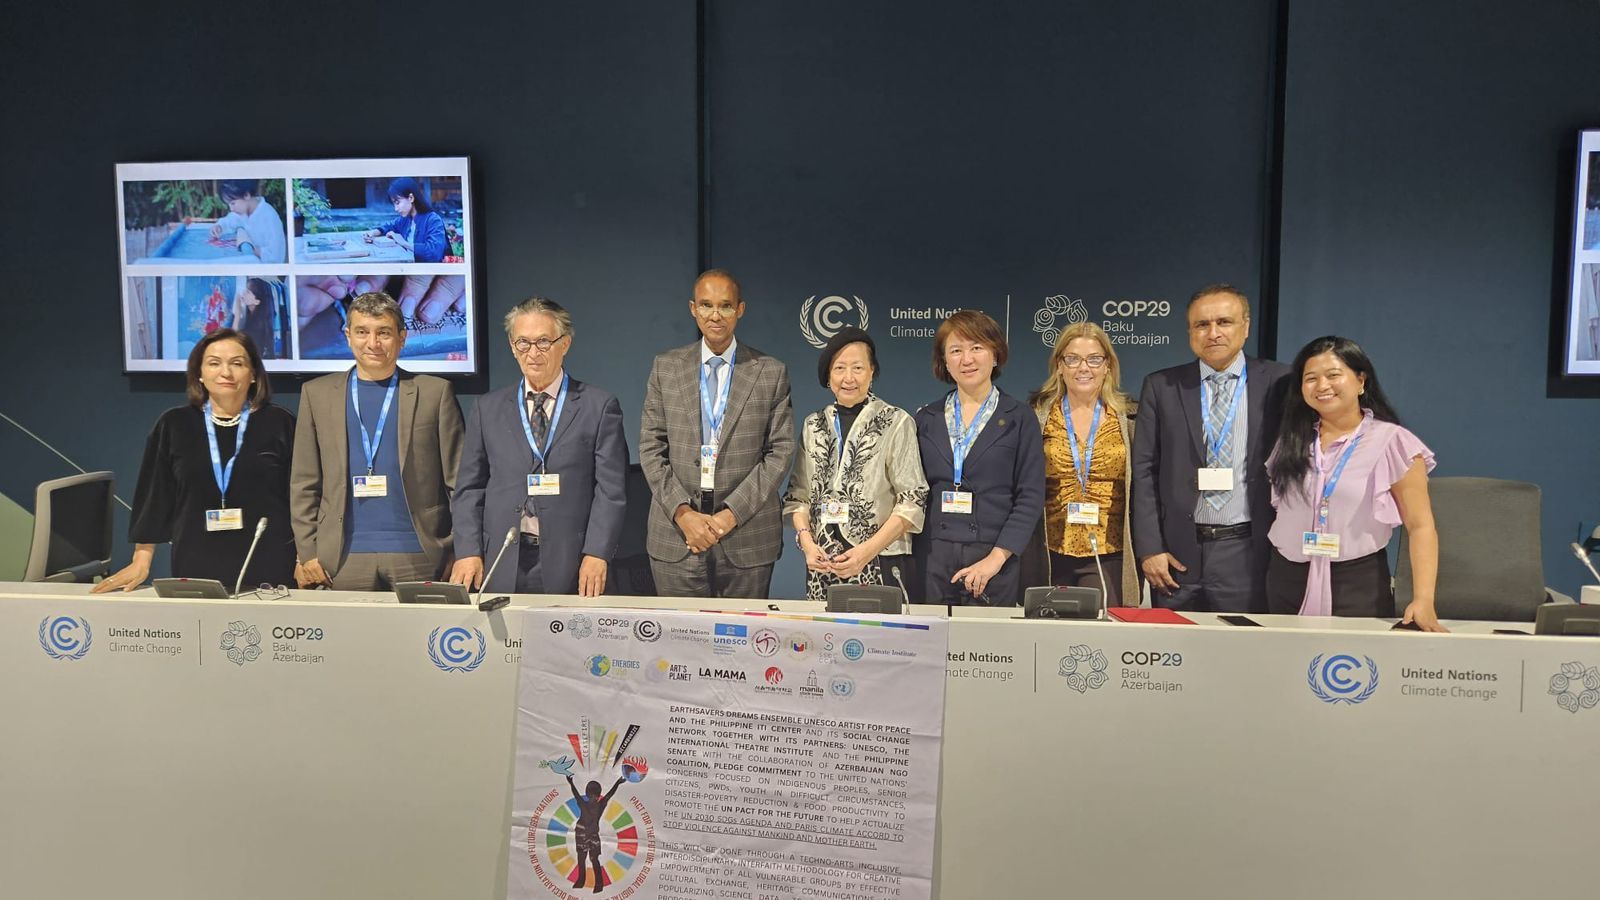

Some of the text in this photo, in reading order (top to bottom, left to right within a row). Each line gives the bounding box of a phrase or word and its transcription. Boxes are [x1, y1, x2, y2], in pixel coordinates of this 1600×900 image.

[890, 308, 931, 320] United
[1103, 300, 1170, 316] COP29
[890, 326, 935, 338] Climate
[1103, 320, 1134, 332] Baku
[1108, 333, 1170, 346] zerbaijan
[598, 618, 630, 628] COP29
[108, 628, 181, 640] United Nations
[272, 626, 324, 640] COP29
[109, 642, 182, 656] Climate Change
[272, 642, 297, 652] Baku
[714, 638, 748, 646] unesco
[272, 652, 324, 664] Azerbaijan
[612, 659, 640, 670] ENERGIES
[970, 652, 1014, 664] Nations
[1121, 651, 1182, 666] COP29
[668, 672, 692, 682] PLANET
[699, 667, 747, 680] LA MAMA
[972, 668, 1014, 682] Change
[1121, 668, 1150, 679] Baku
[1402, 668, 1498, 682] United Nations
[1121, 680, 1183, 693] Azerbaijan
[1401, 684, 1498, 701] Climate Change
[670, 706, 724, 717] EARTHSAVERS
[726, 711, 758, 720] DREAMS
[760, 714, 802, 724] ENSEMBLE
[804, 718, 837, 727] UNESCO
[838, 721, 866, 730] ARTIST
[885, 725, 911, 734] PEACE
[668, 726, 706, 736] NETWORK
[712, 731, 754, 741] TOGETHER
[760, 735, 780, 743] WITH
[785, 737, 798, 745] ITS
[670, 716, 686, 724] AND
[690, 718, 706, 726] THE
[710, 720, 752, 730] PHILIPPINE
[771, 726, 802, 735] CENTER
[806, 729, 822, 737] AND
[842, 732, 872, 741] SOCIAL
[876, 735, 910, 745] CHANGE
[668, 737, 910, 766] INTERNATIONAL THEATRE INSTITUTE AND THE PHILIPPINE
[668, 748, 697, 757] SENATE
[702, 751, 722, 759] WITH
[748, 756, 814, 768] COLLABORATION
[834, 764, 884, 775] AZERBAIJAN
[890, 769, 908, 777] NGO
[666, 758, 710, 770] COALITION,
[714, 763, 744, 772] PLEDGE
[748, 766, 802, 778] COMMITMENT
[820, 773, 834, 781] THE
[838, 775, 866, 784] UNITED
[666, 769, 708, 779] CONCERNS
[716, 773, 752, 783] FOCUSED
[777, 779, 826, 790] INDIGENOUS
[878, 789, 907, 798] SENIOR
[740, 786, 766, 795] YOUTH
[790, 791, 830, 802] DIFFICULT
[664, 800, 904, 831] PROMOTE THE UN PACT FOR THE FUTURE TO HELP ACTUALIZE
[744, 797, 788, 808] REDUCTION
[804, 803, 826, 812] FOOD
[832, 806, 888, 818] PRODUCTIVITY
[894, 812, 905, 820] TO
[663, 820, 848, 846] STOP VIOLENCE AGAINST MANKIND AND MOTHER
[664, 810, 904, 842] THE UN 2030 AGENDA AND PARIS CLIMATE ACCORD TO
[629, 795, 655, 889] PACT FOR THE FUTURE GLOBAL
[662, 842, 679, 850] THIS
[720, 848, 742, 857] DONE
[746, 851, 785, 861] THROUGH
[660, 863, 900, 895] EMPOWERMENT OF ALL VULNERABLE GROUPS BY EFFECTIVE
[738, 860, 901, 884] INTERFAITH METHODOLOGY FOR CREATIVE
[658, 873, 699, 884] CULTURAL
[756, 884, 794, 895] HERITAGE
